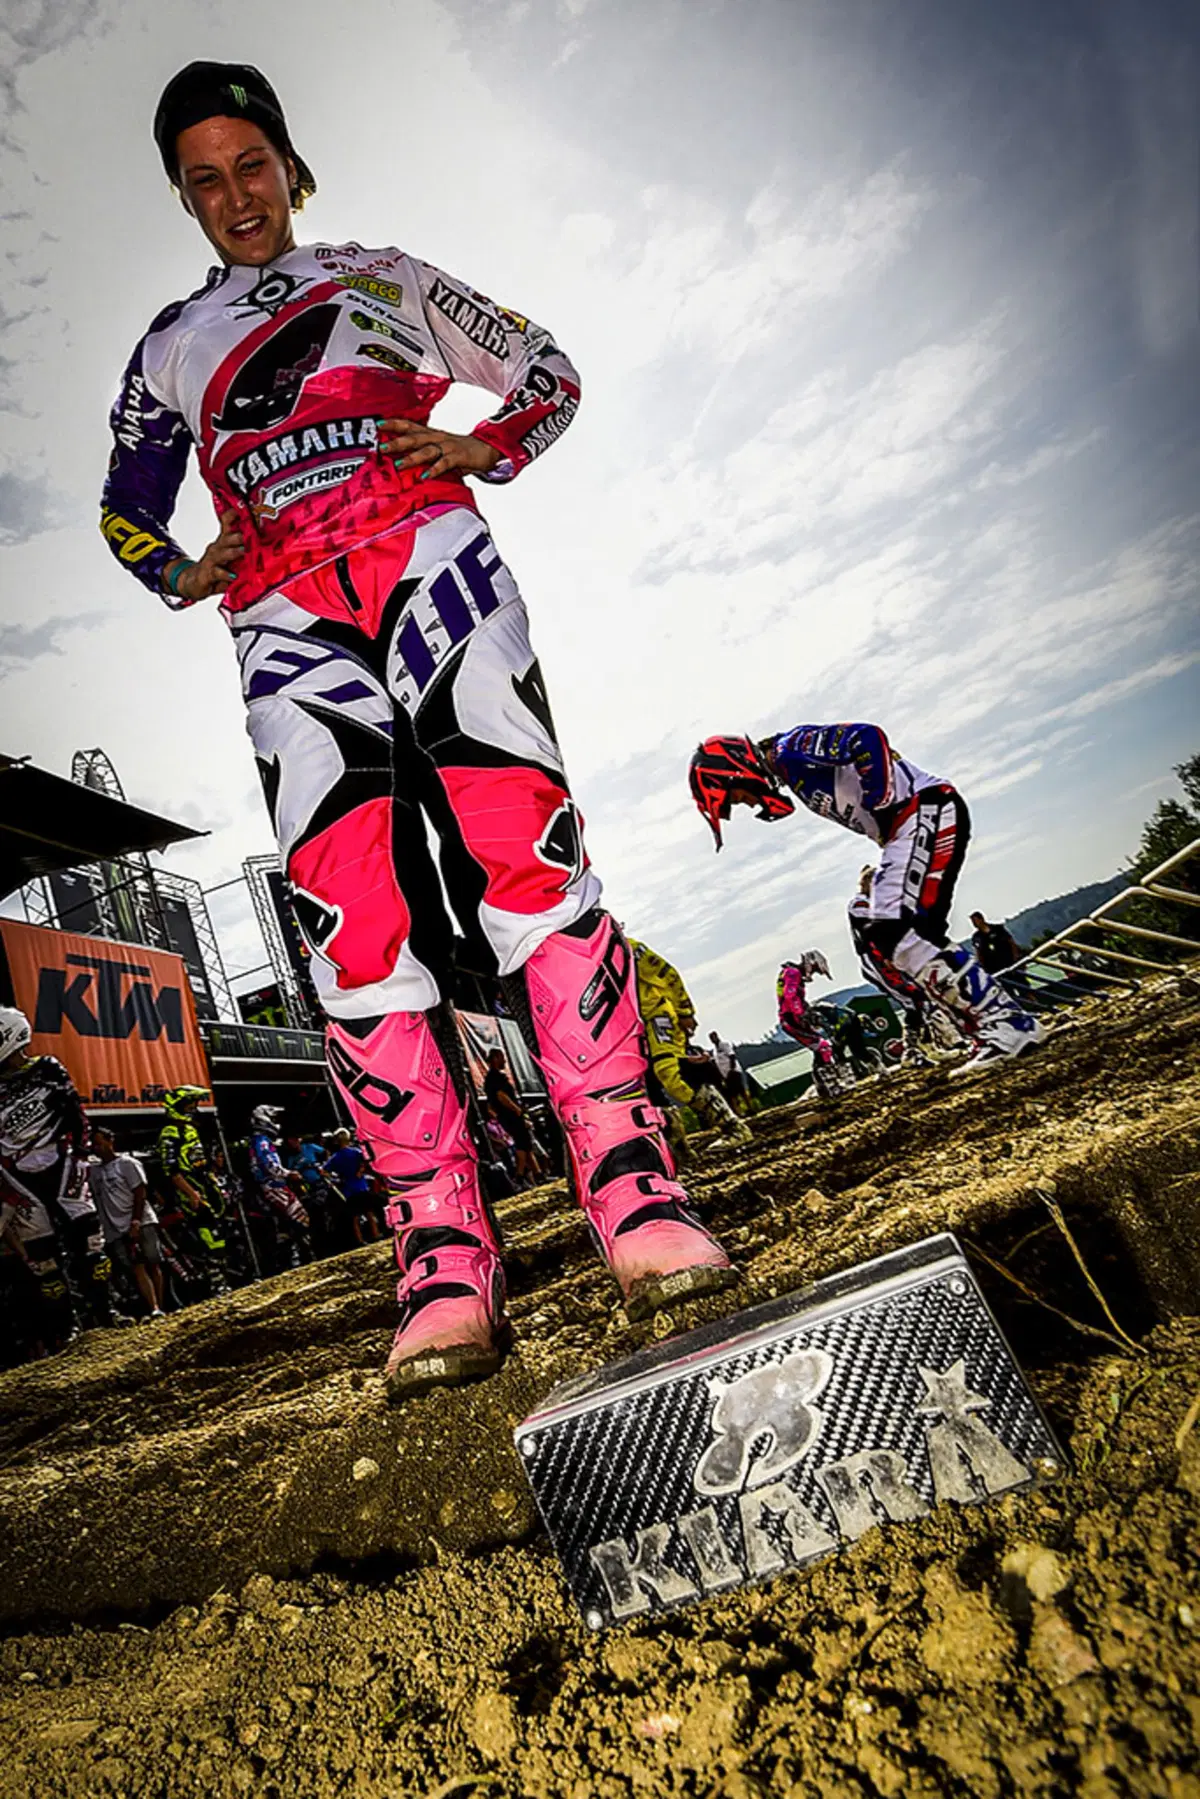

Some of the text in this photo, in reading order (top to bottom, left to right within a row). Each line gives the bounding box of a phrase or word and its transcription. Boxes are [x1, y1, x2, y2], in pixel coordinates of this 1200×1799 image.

[227, 418, 379, 494] YAMAHA
[34, 953, 186, 1045] KTM
[92, 1082, 126, 1103] KTM
[590, 1385, 1033, 1619] KIARA
